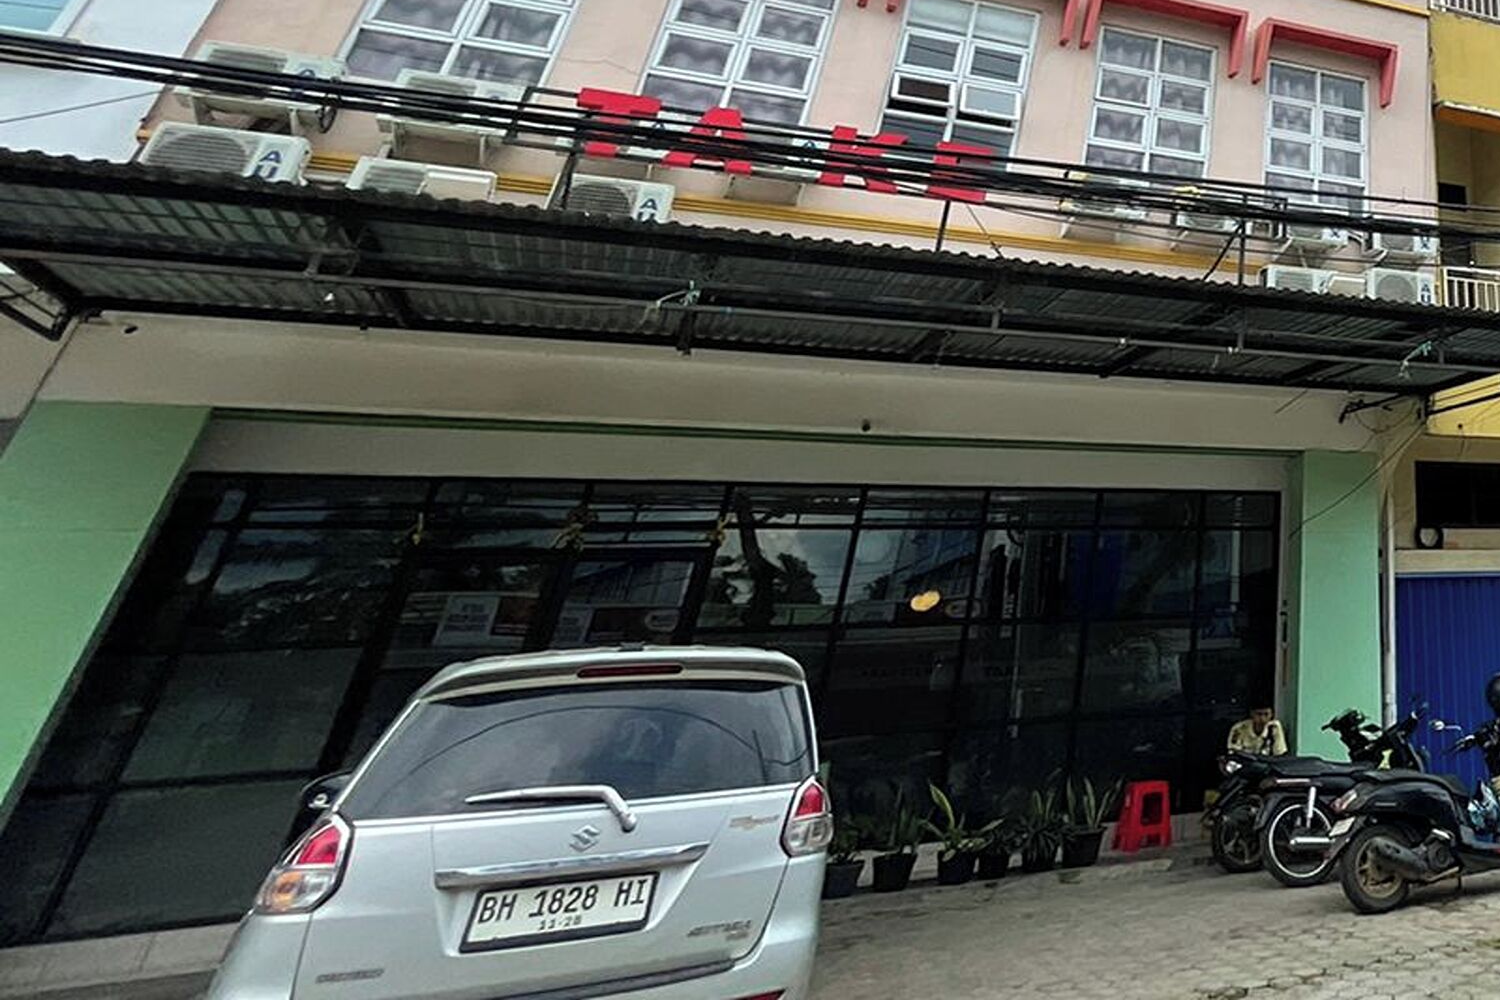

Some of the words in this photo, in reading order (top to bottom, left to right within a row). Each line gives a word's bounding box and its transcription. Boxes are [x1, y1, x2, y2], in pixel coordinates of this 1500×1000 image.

[477, 893, 518, 924] BH
[529, 884, 599, 918] 1828
[614, 879, 648, 907] HI
